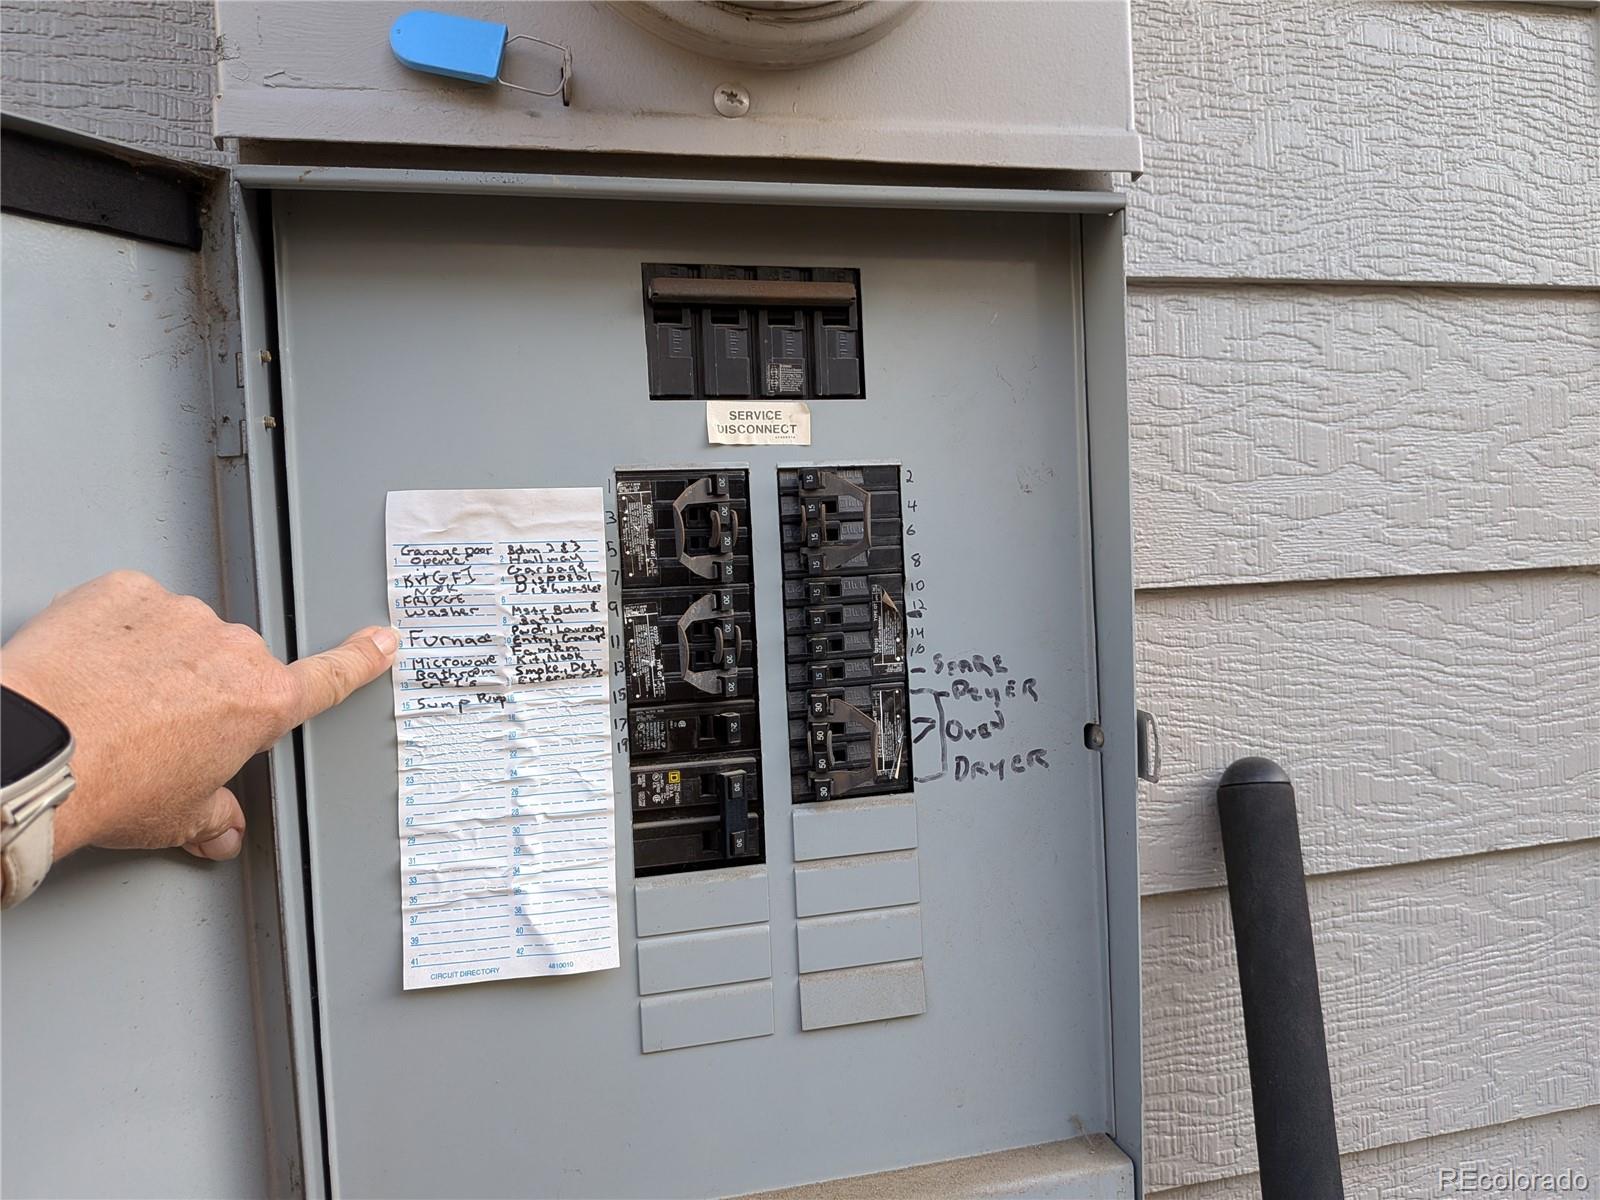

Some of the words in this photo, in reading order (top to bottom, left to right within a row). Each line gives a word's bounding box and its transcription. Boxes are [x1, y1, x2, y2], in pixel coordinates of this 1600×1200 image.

[728, 410, 782, 420] SERVICE
[716, 424, 798, 434] DISCONNECT
[806, 474, 814, 483] 15
[906, 469, 914, 484] 2
[719, 478, 726, 488] 20
[721, 506, 728, 516] 20
[808, 504, 816, 512] 15
[907, 500, 918, 512] 4
[604, 510, 618, 525] 3
[906, 524, 916, 536] 6
[724, 536, 731, 546] 20
[811, 532, 818, 541] 15
[570, 540, 581, 552] 3
[606, 540, 618, 558] 5
[400, 545, 460, 559] Garage
[410, 555, 474, 568] Opener
[812, 560, 820, 568] 15
[910, 552, 922, 568] 8
[726, 565, 732, 575] 20
[514, 572, 592, 587] Disposal
[610, 570, 620, 586] 7
[910, 580, 926, 592] 10
[813, 588, 820, 597] 15
[723, 594, 730, 604] 20
[608, 601, 620, 618] 9
[912, 598, 928, 612] 12
[405, 607, 479, 618] Washer
[814, 616, 822, 625] 15
[724, 624, 732, 633] 20
[910, 627, 926, 639] 14
[610, 634, 620, 650] 11
[816, 644, 823, 653] 15
[910, 643, 926, 657] 16
[412, 654, 497, 670] Microwave
[726, 654, 734, 664] 20
[614, 660, 626, 676] 13
[416, 667, 496, 681] Bathroom
[816, 672, 823, 681] 15
[728, 682, 735, 692] 20
[612, 688, 626, 704] 15
[418, 698, 471, 714] Sump
[815, 702, 823, 712] 30
[614, 718, 628, 732] 17
[816, 730, 824, 740] 50
[616, 738, 630, 754] 19
[818, 758, 826, 769] 50
[510, 769, 518, 777] 24
[820, 786, 828, 797] 30
[408, 857, 416, 865] 31
[410, 916, 418, 924] 37
[548, 961, 574, 969] 4810010
[430, 970, 460, 980] CIRCUIT
[460, 968, 500, 978] DIRECTORY
